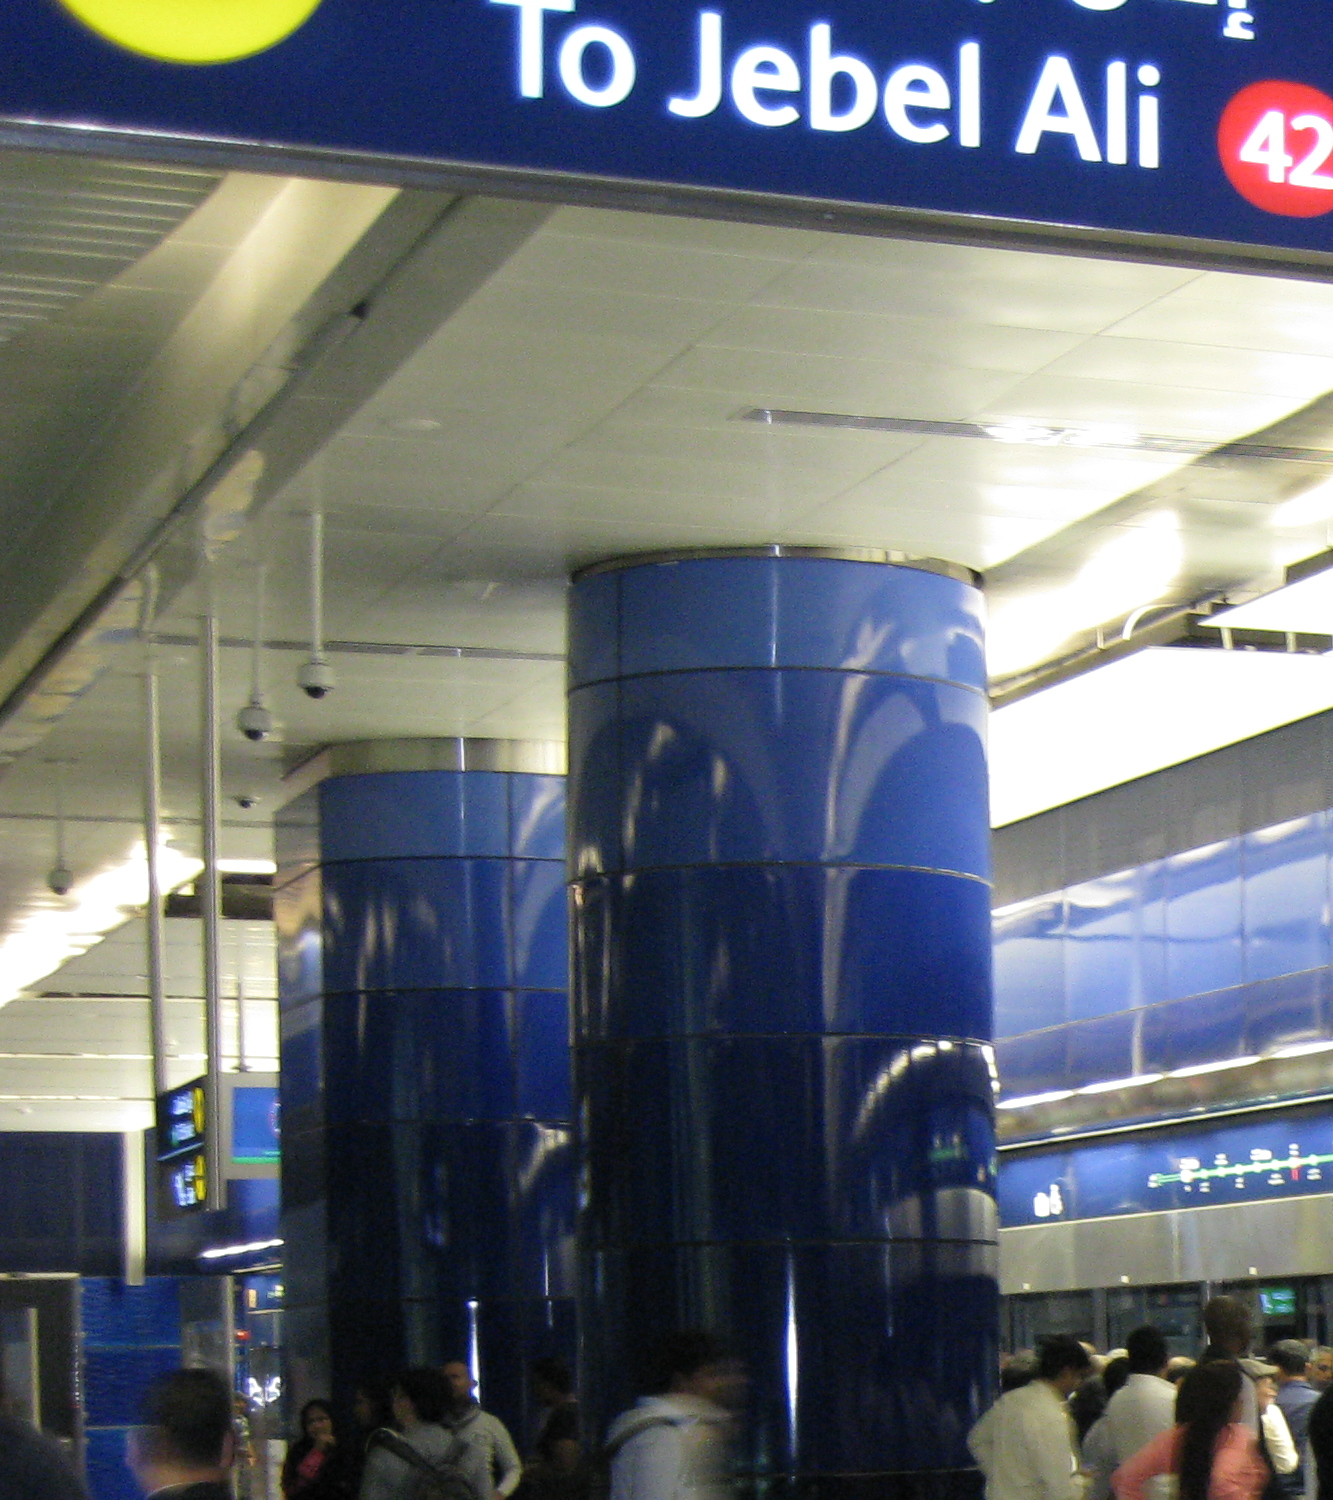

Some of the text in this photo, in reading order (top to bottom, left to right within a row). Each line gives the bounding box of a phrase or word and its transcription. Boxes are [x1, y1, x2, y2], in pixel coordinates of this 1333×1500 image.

[491, 0, 1161, 169] To Jebel Ali
